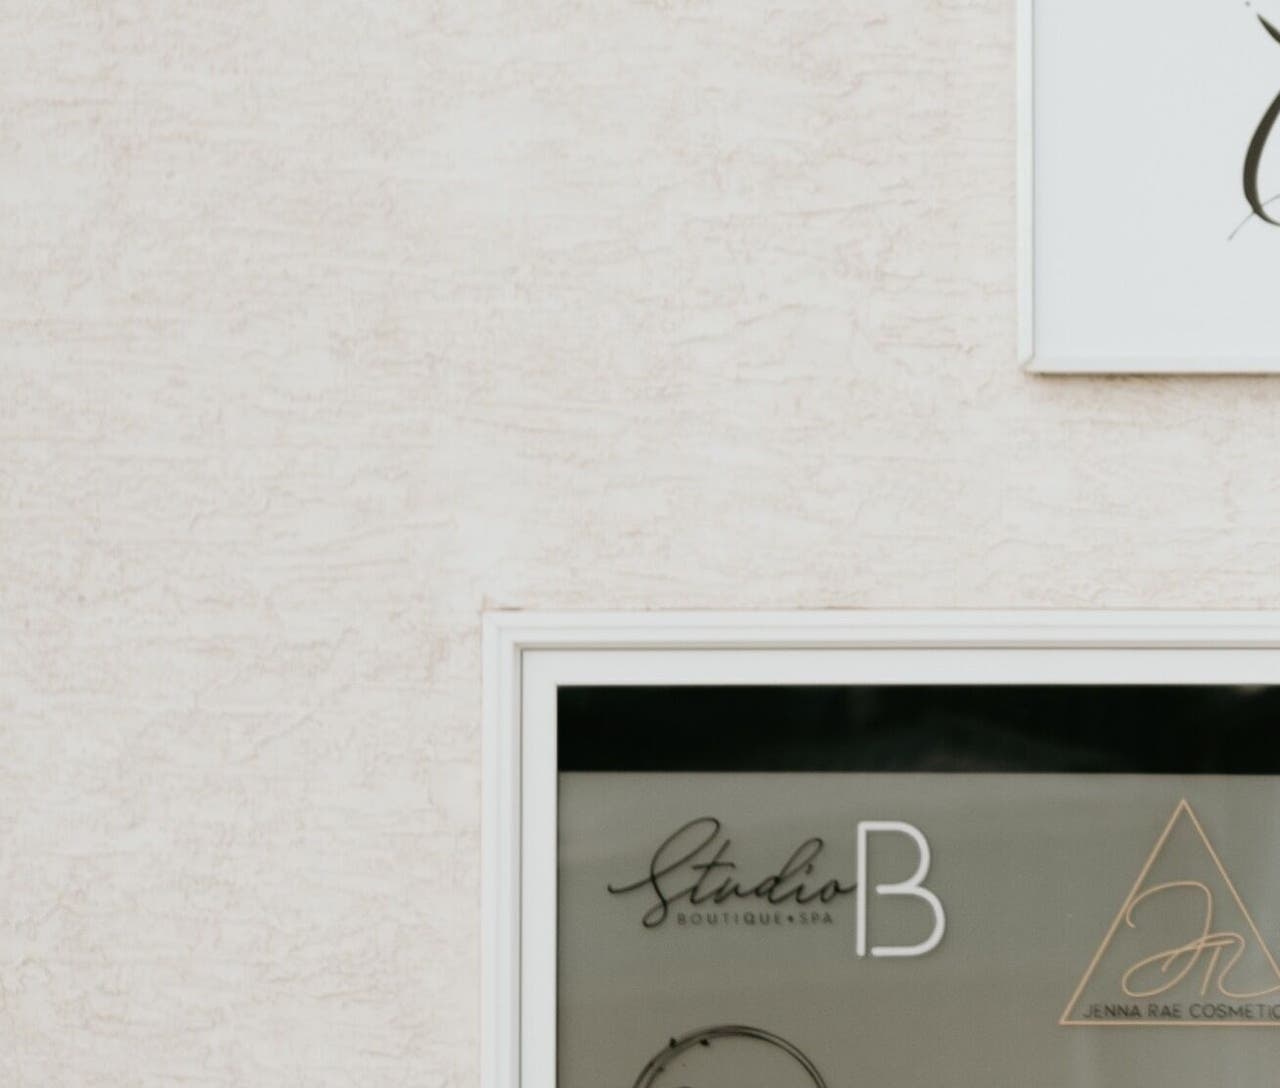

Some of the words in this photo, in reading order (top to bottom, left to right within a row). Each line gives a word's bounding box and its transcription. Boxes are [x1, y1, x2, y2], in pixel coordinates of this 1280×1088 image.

[607, 817, 857, 928] Studio
[856, 820, 946, 957] B
[1083, 1003, 1140, 1019] JENNA
[1147, 1003, 1181, 1019] RAE
